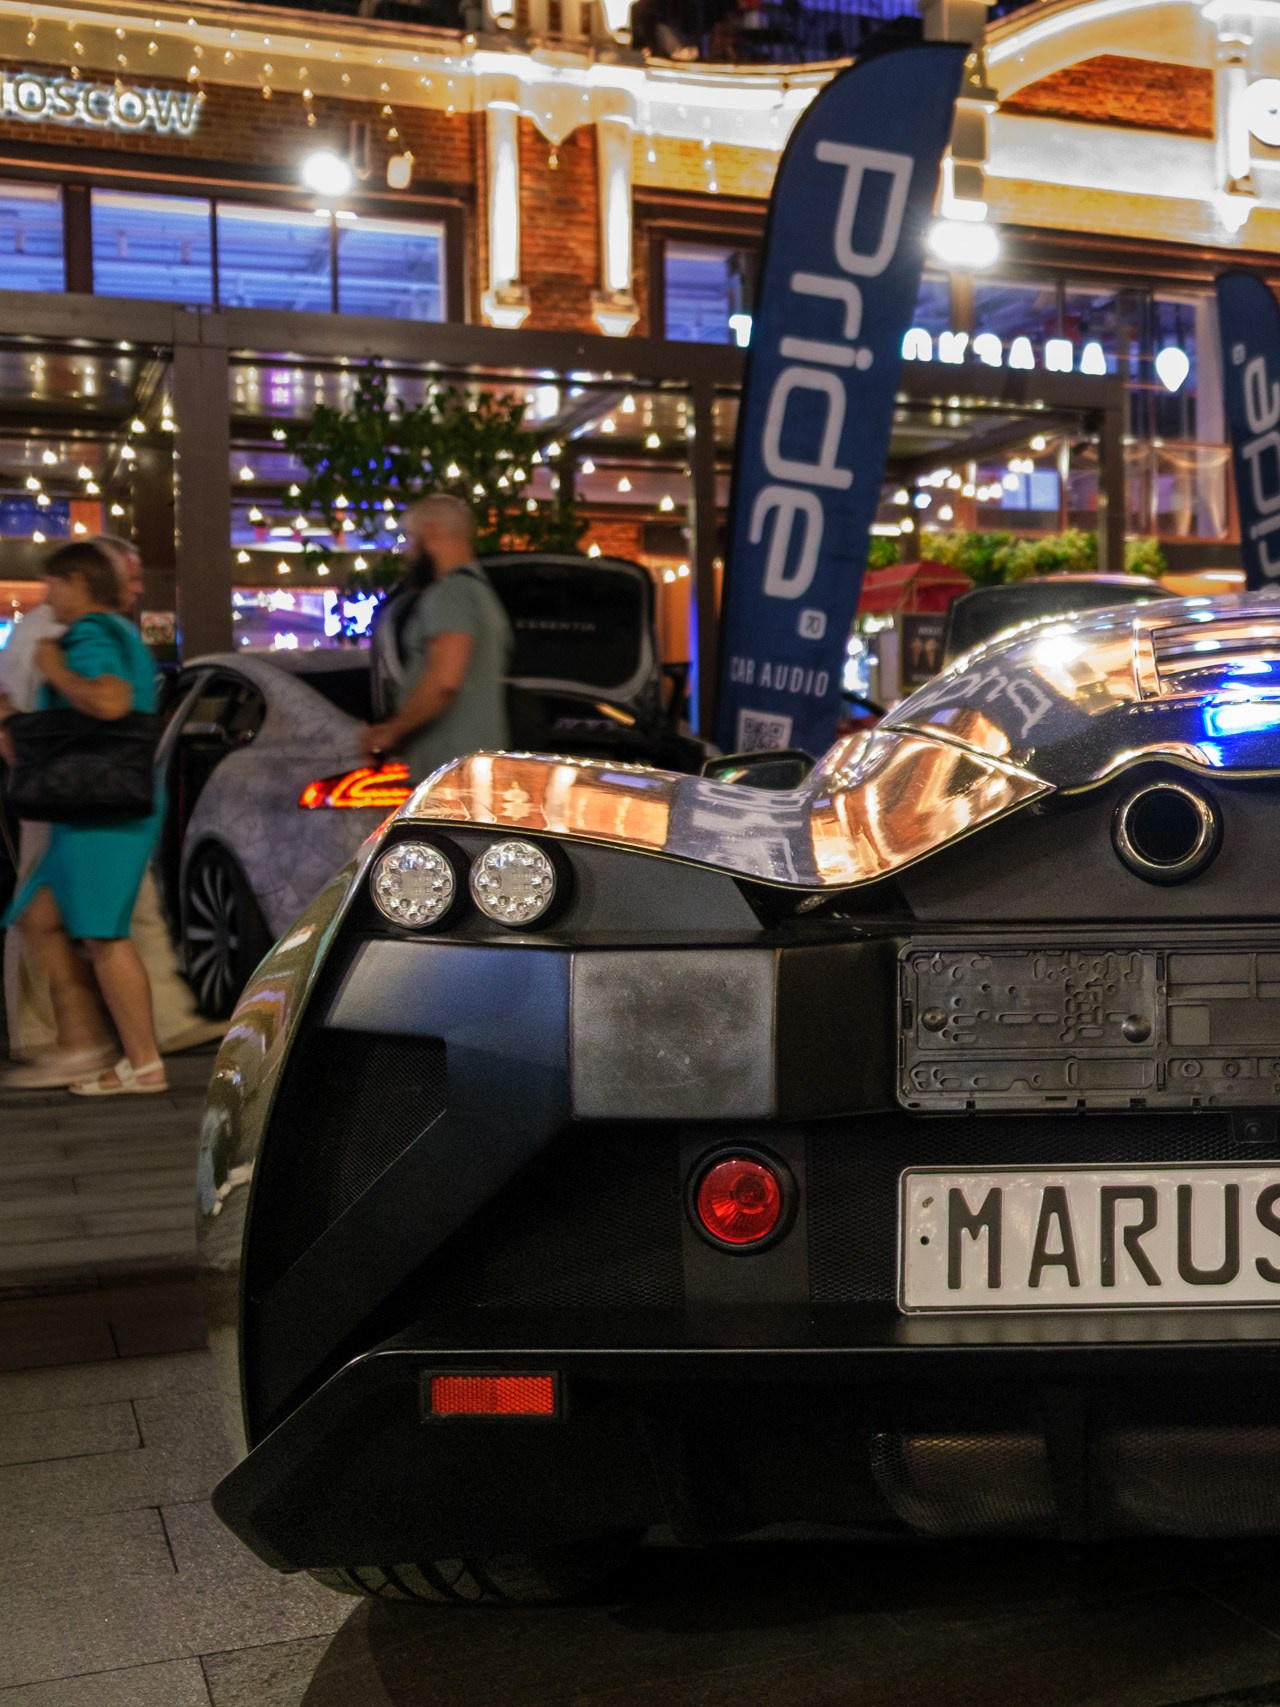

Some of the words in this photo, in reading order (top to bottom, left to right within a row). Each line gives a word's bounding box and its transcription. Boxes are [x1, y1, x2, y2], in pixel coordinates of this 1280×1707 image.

[0, 73, 203, 132] OSCOW
[748, 140, 914, 600] Pride
[730, 656, 756, 685] CAR
[760, 661, 830, 698] AUDIO
